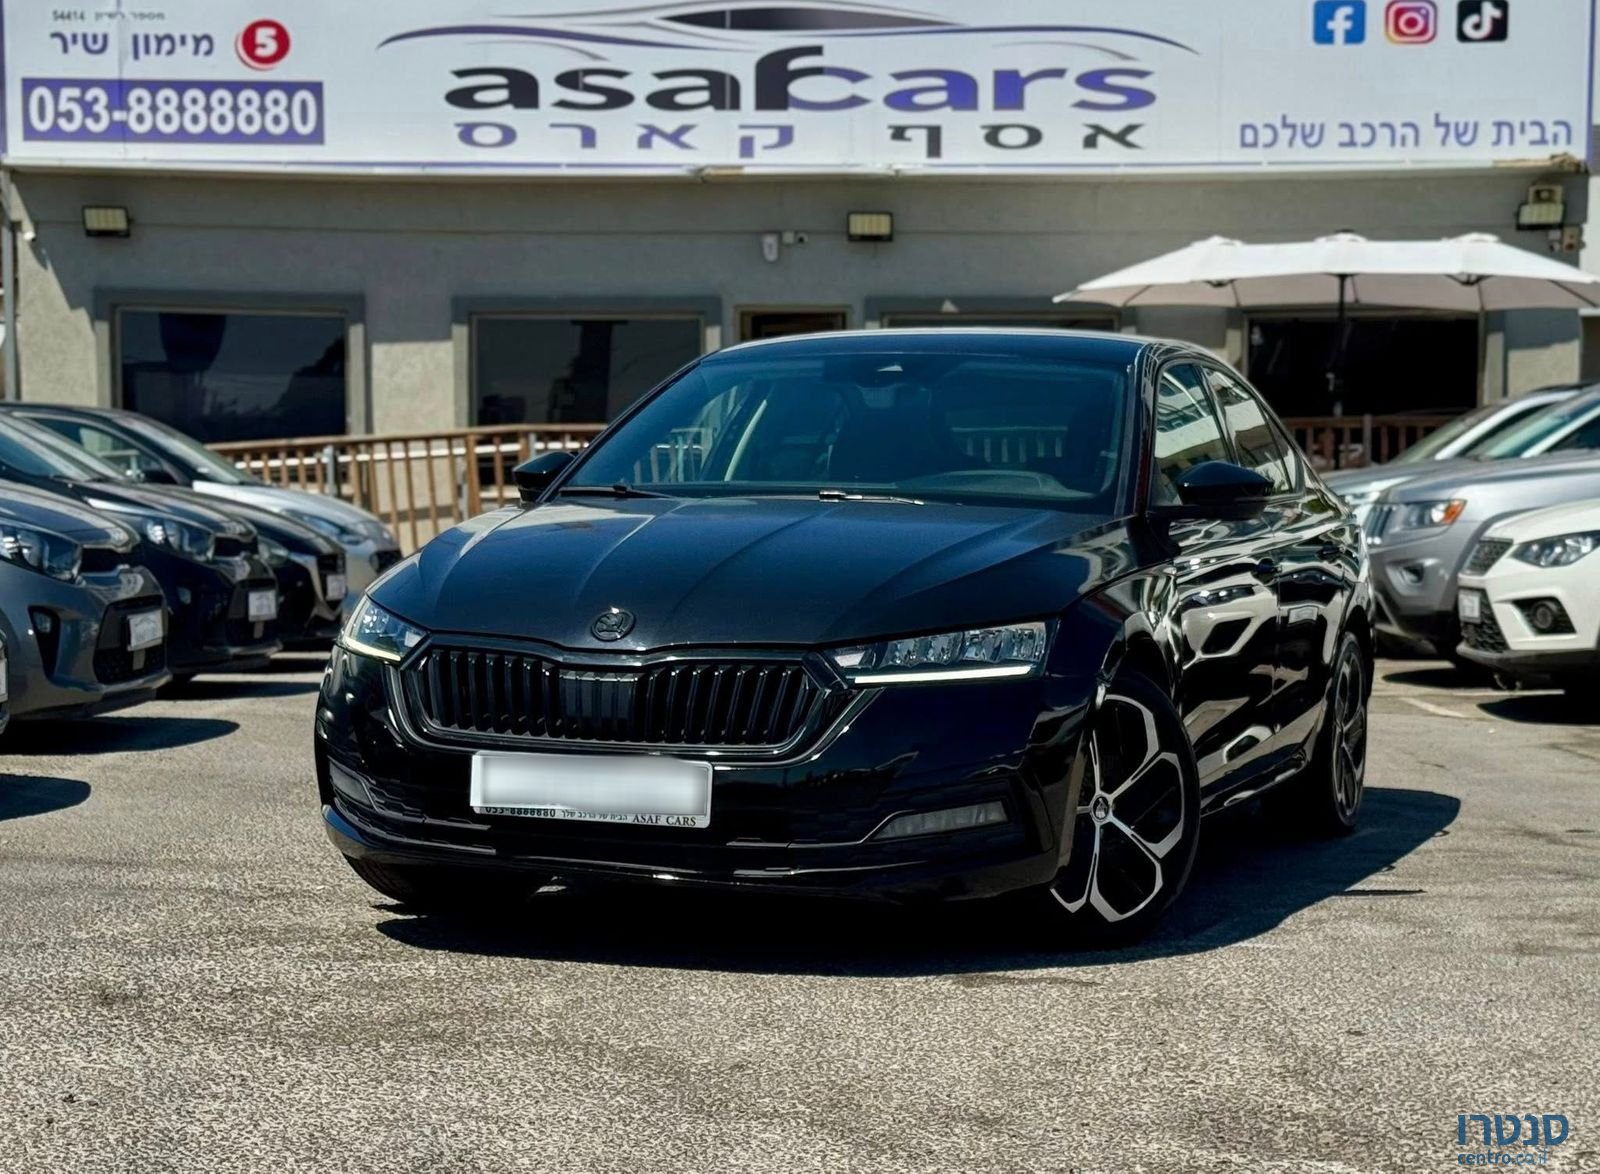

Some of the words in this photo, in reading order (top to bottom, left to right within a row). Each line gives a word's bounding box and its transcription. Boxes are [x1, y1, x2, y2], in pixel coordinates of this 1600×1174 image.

[50, 32, 108, 55] שיר
[132, 33, 214, 60] מימון
[254, 28, 278, 57] 5
[28, 86, 318, 135] 053-8888880
[453, 122, 795, 158] קארס
[886, 123, 1146, 158] אסף
[1240, 114, 1325, 149] שלכם
[1338, 122, 1419, 147] הרכב
[1434, 113, 1478, 146] של
[1491, 120, 1572, 146] הבית
[632, 813, 661, 824] ASAF
[666, 815, 696, 827] CARS
